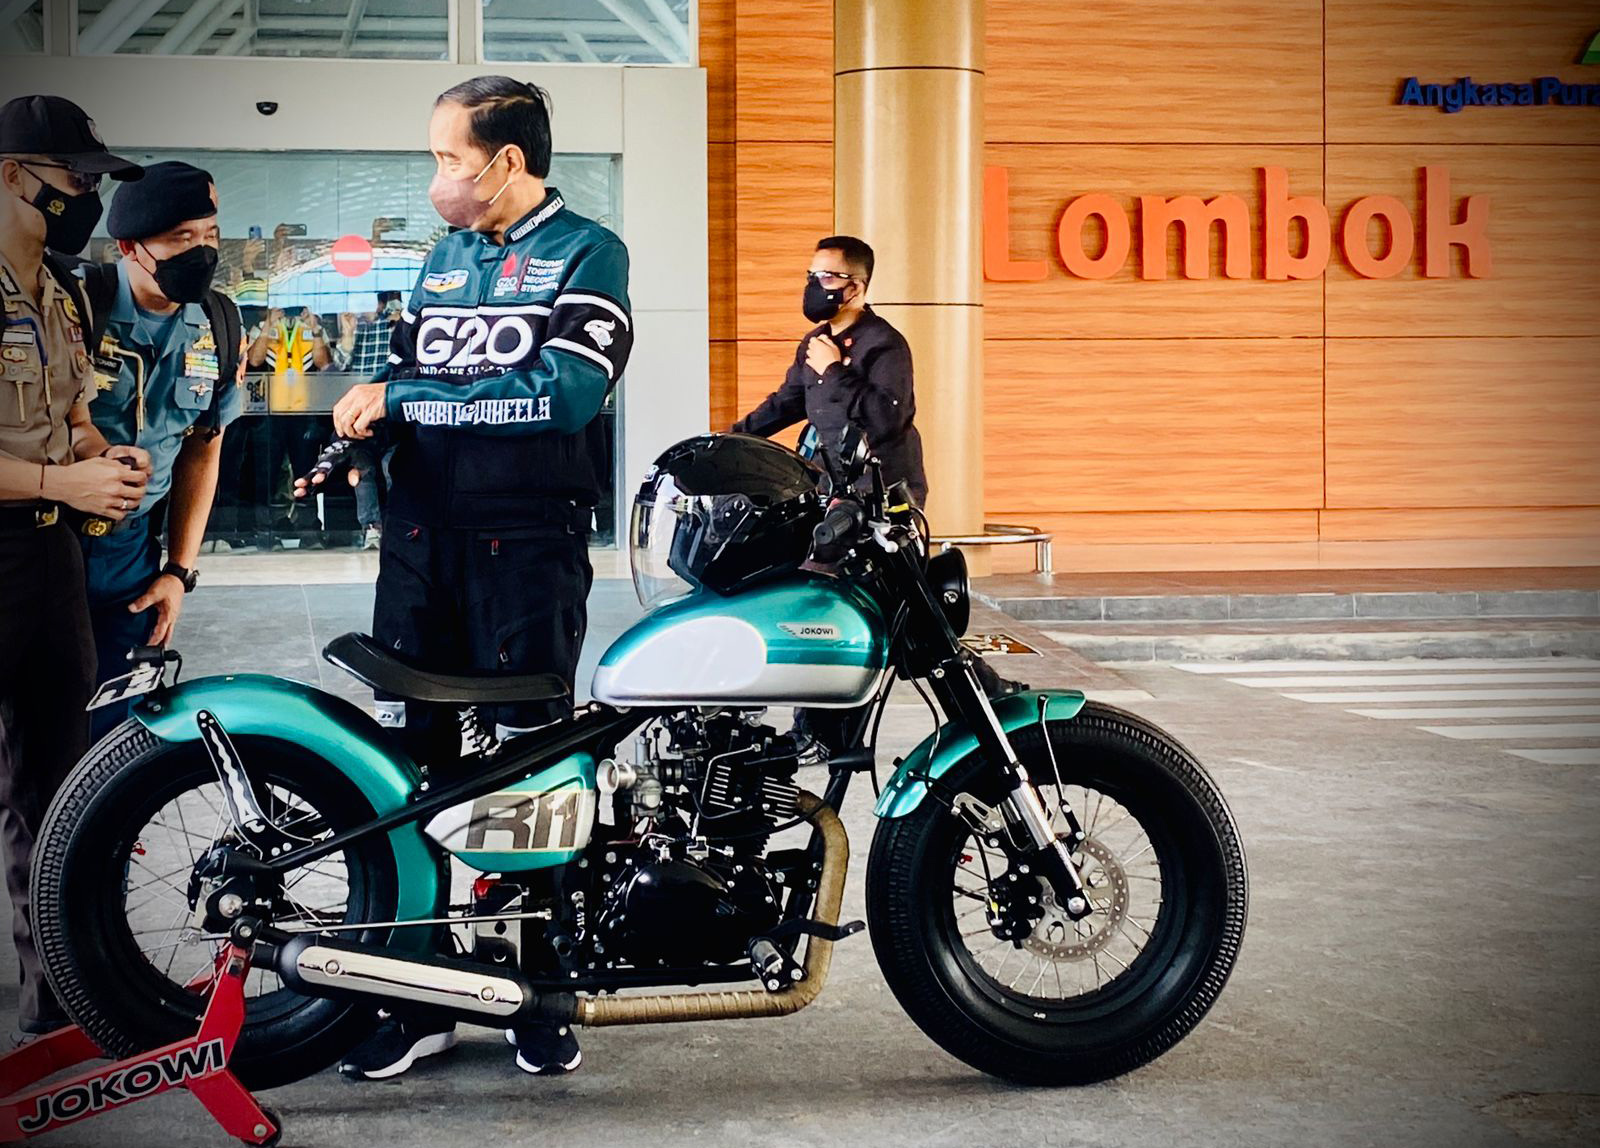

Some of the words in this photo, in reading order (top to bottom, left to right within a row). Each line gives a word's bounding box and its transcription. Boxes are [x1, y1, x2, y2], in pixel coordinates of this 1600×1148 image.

[1401, 76, 1534, 113] Angkasa
[1537, 76, 1600, 105] Pura
[984, 165, 1492, 280] Lombok
[416, 316, 533, 367] G20
[800, 627, 834, 635] JOKOWI
[18, 1038, 226, 1133] JOKOWI
